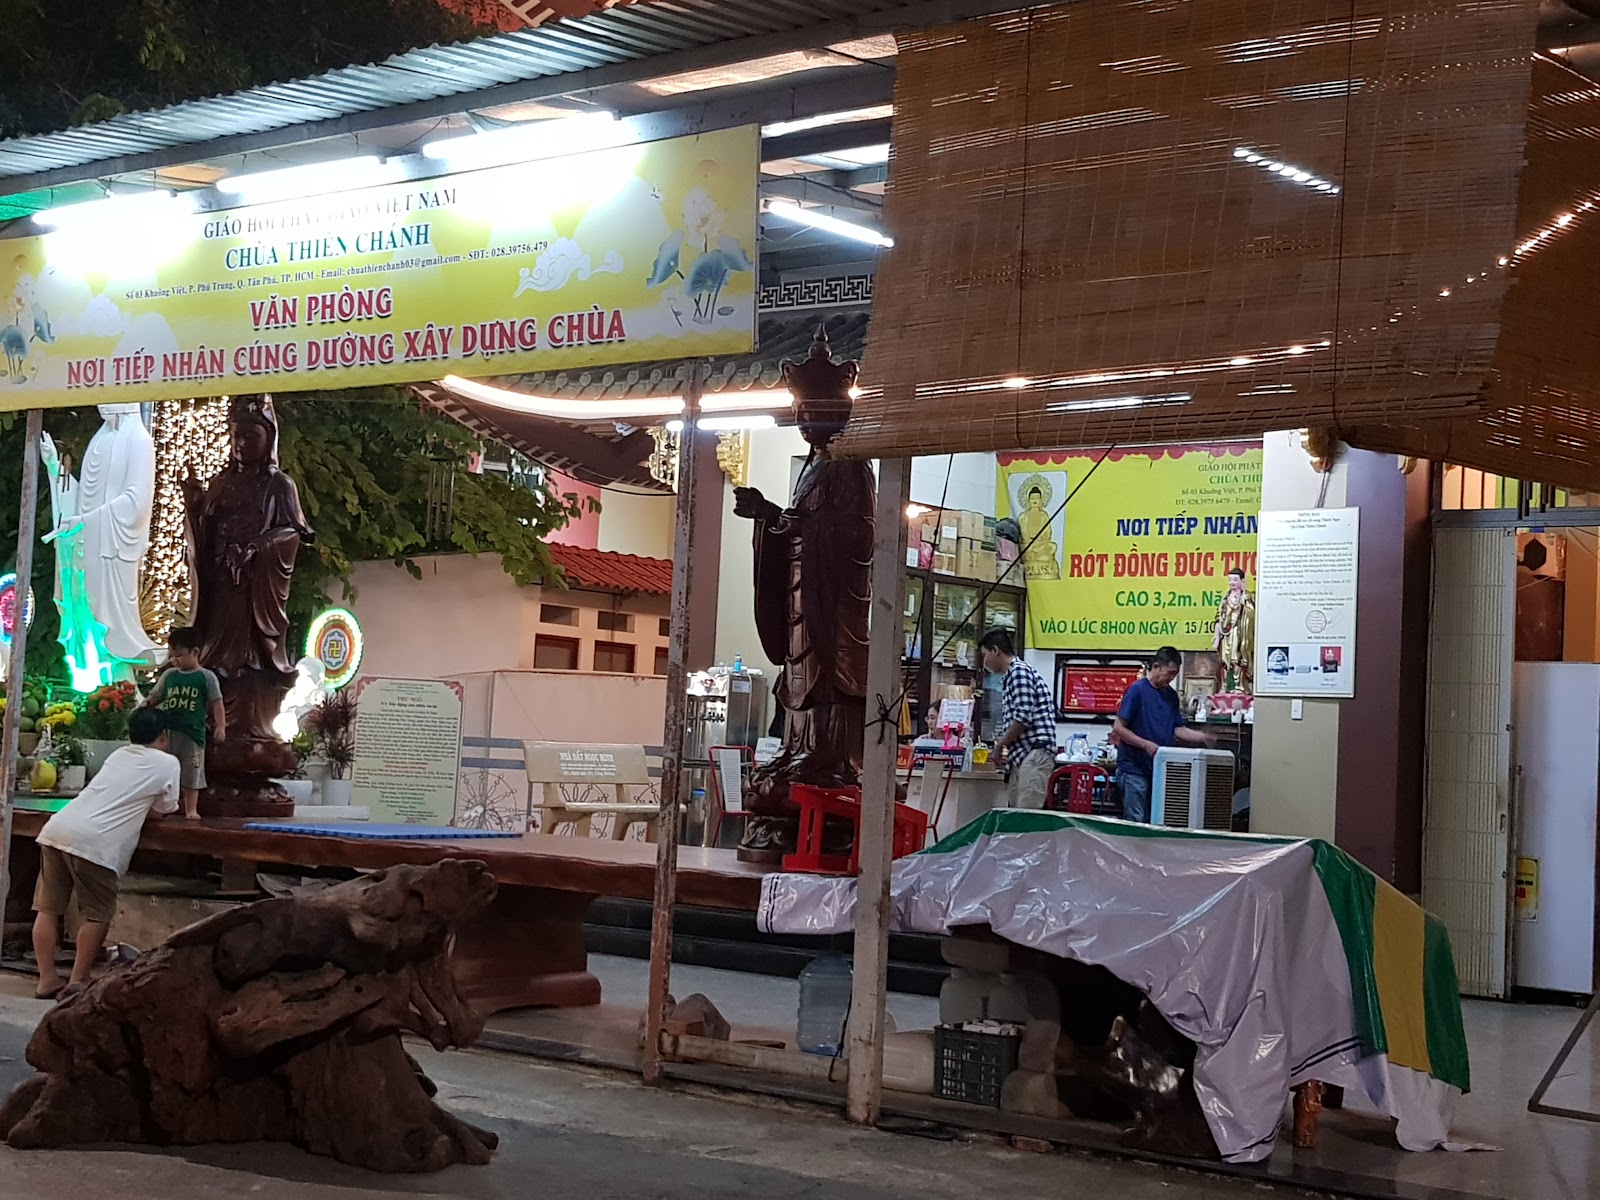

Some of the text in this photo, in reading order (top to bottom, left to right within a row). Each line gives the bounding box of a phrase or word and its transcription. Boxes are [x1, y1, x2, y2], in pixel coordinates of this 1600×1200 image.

[204, 215, 242, 239] GIÁO
[418, 187, 457, 209] NAM
[225, 240, 278, 270] CHÙA
[287, 231, 347, 262] THIÊN
[355, 221, 431, 254] CHÁNH
[281, 273, 293, 283] TP.
[295, 271, 314, 282] HCM
[321, 267, 345, 279] Email:
[250, 286, 392, 330] VĂN PHÒNG
[67, 304, 627, 388] NƠI TIẾP NHẬN CÚNG DƯỜNG XÂY DỰNG CHÙA
[1209, 473, 1239, 484] CHÙA
[1116, 511, 1258, 538] NƠI TIẾP NHẬN
[1069, 548, 1109, 578] RÓT
[1113, 543, 1169, 577] ĐỒNG
[1174, 547, 1214, 577] ĐÚC
[1115, 591, 1149, 607] CAO
[1153, 590, 1197, 609] 3,2m.
[1040, 619, 1068, 634] VÀO
[1071, 618, 1098, 634] LÚC
[1100, 621, 1136, 634] 8H00
[1139, 619, 1178, 635] NGÀY
